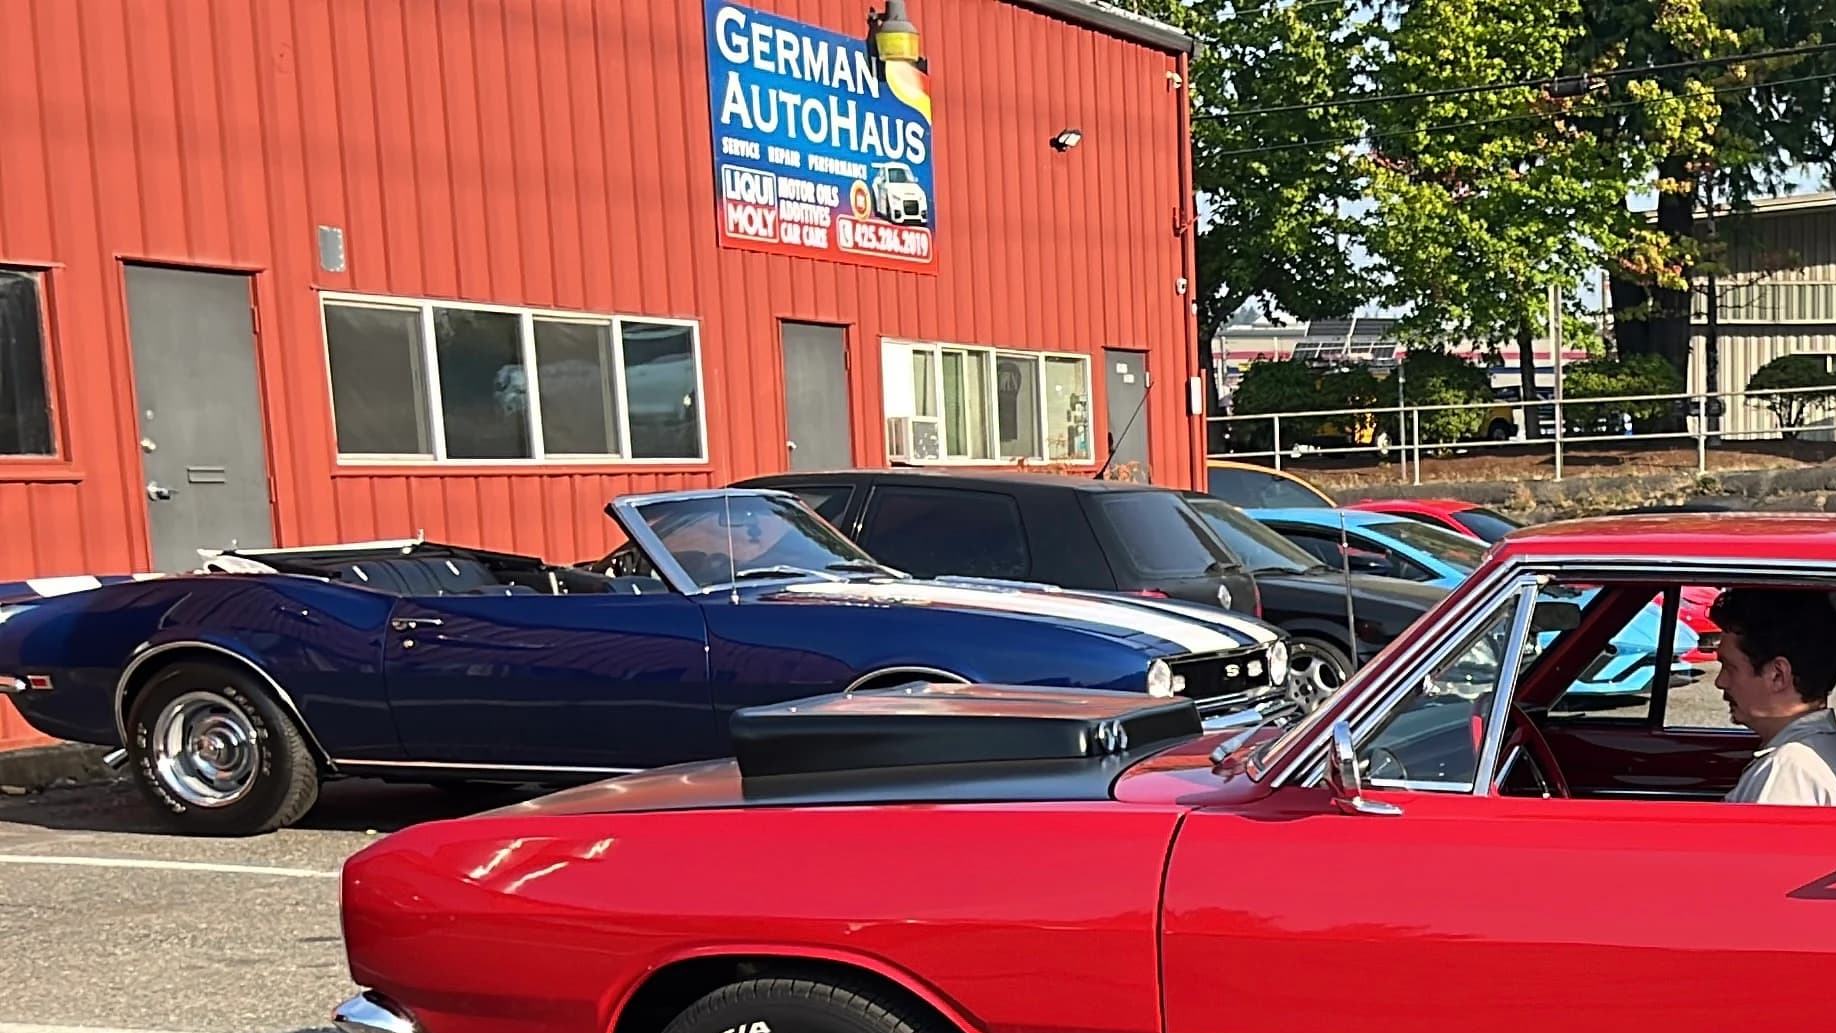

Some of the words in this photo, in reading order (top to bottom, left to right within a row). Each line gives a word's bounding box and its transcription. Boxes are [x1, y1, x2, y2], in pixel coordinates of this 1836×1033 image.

[716, 6, 880, 98] GERMAN
[721, 71, 925, 164] AUTOHAUS
[722, 136, 761, 160] SERVICE
[767, 145, 801, 168] REPAIR
[808, 154, 868, 180] PERFORMANCE
[725, 169, 775, 206] LIQUI
[777, 176, 815, 203] MOTOR
[816, 183, 839, 208] OILS
[727, 203, 776, 238] MOLY
[779, 199, 831, 228] ADDITIVES
[780, 222, 802, 245] CAR
[802, 225, 829, 249] CARE
